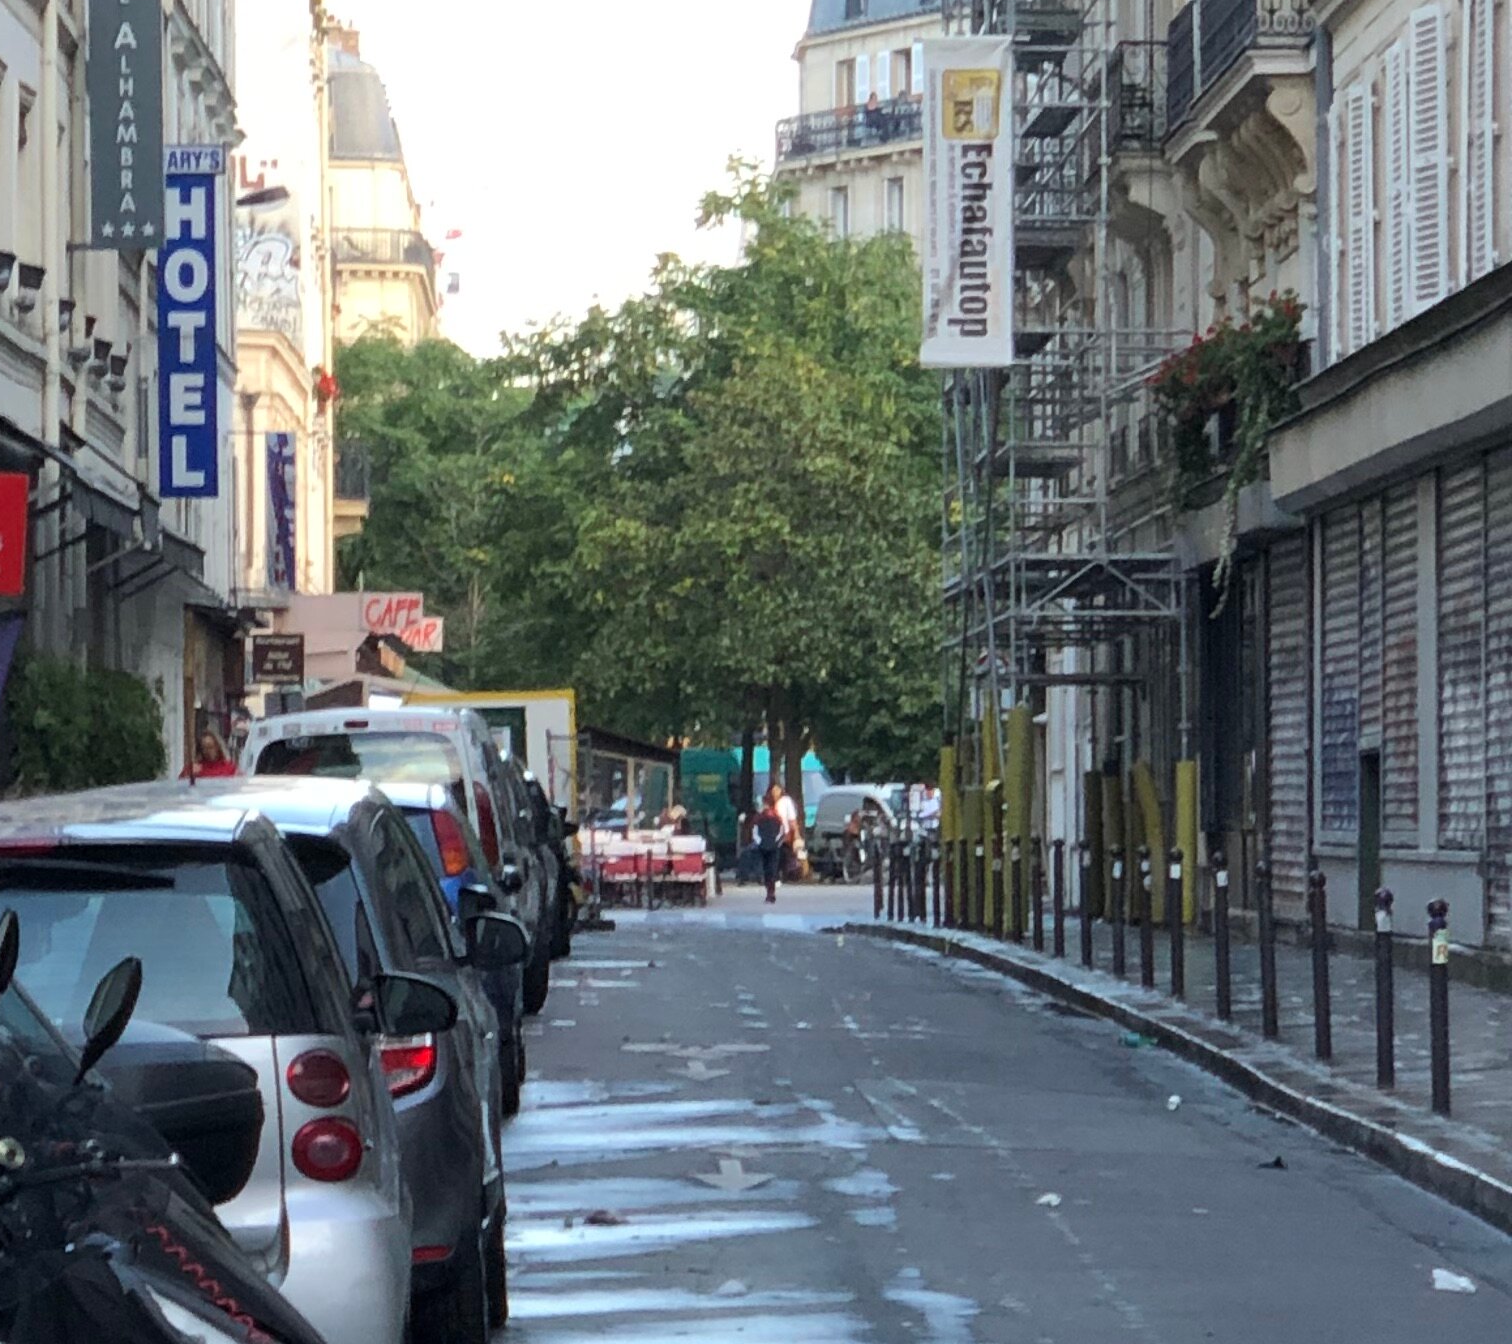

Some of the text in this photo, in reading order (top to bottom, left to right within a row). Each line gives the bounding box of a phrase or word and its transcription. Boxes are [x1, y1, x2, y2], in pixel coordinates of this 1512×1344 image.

[113, 21, 138, 214] ALHAMBRA
[163, 187, 209, 489] HOTEL
[947, 143, 994, 339] Echafautop
